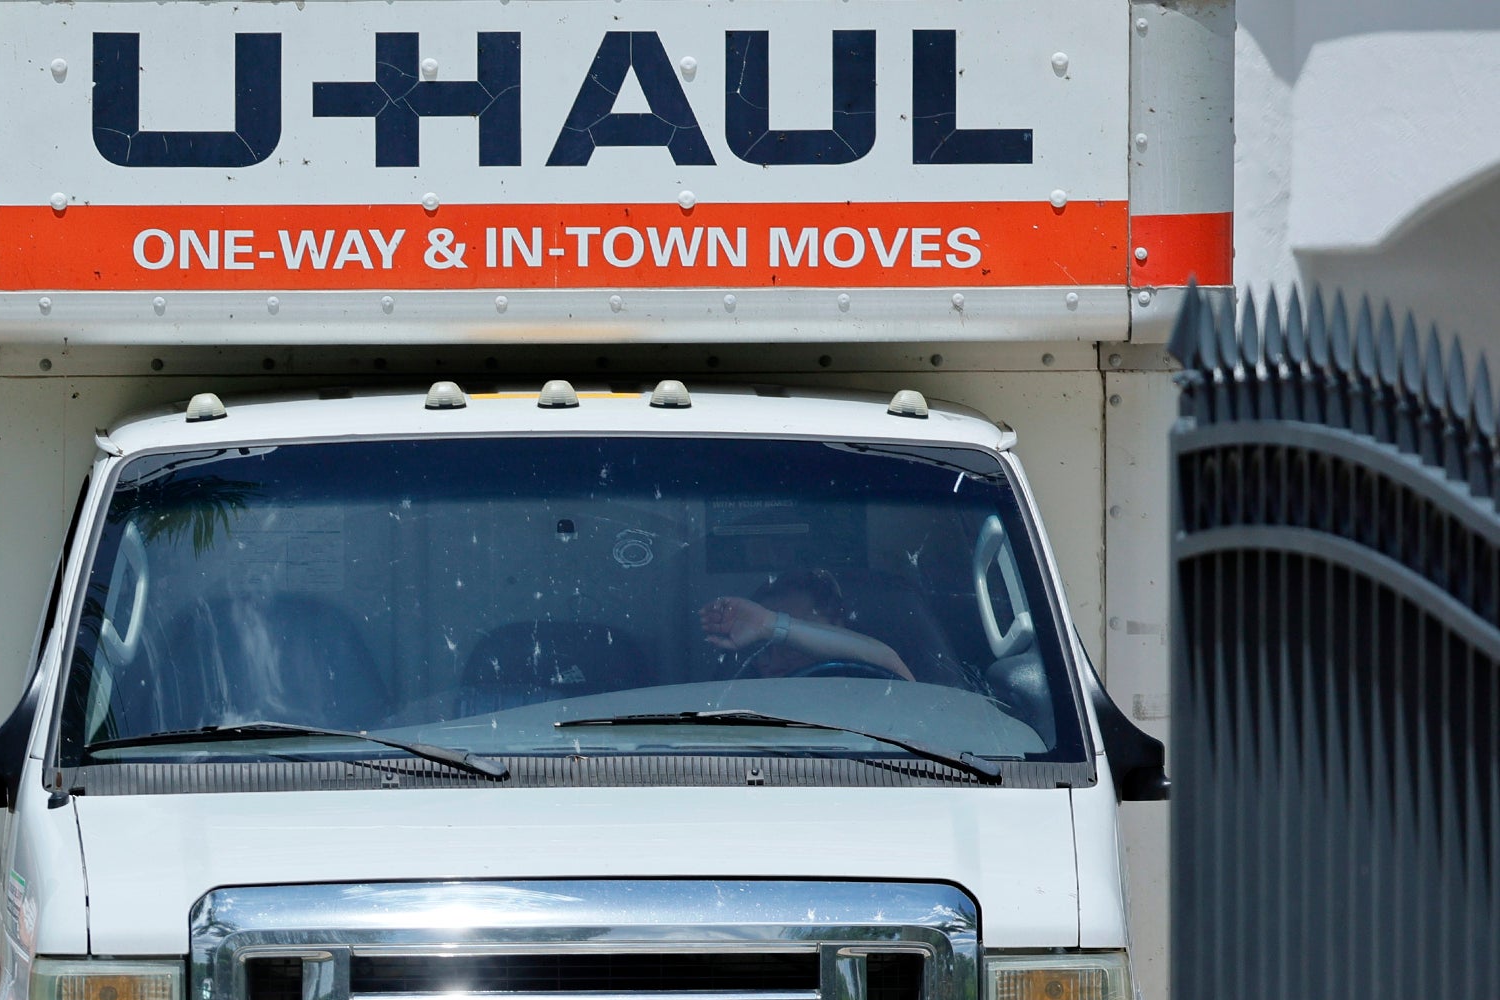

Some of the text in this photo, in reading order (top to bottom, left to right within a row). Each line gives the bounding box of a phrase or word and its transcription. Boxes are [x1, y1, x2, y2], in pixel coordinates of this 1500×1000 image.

[91, 29, 1034, 168] U-HAUL
[132, 226, 982, 270] ONE-WAY & IN-TOWN MOVES
